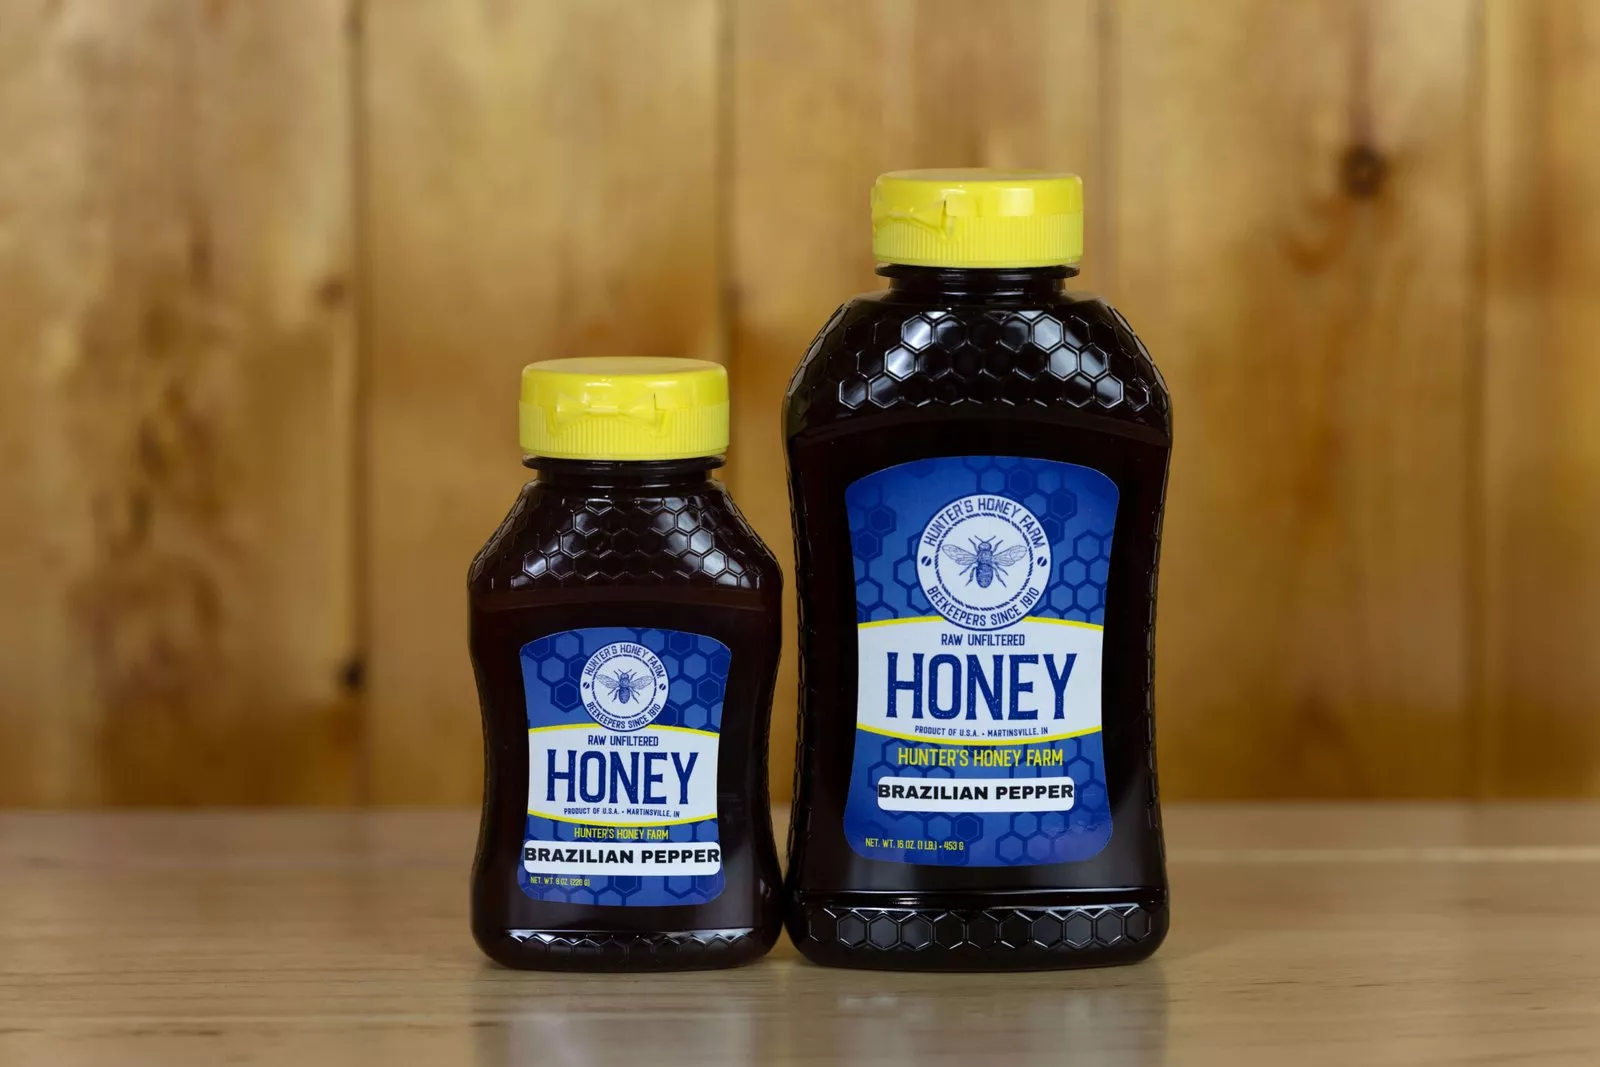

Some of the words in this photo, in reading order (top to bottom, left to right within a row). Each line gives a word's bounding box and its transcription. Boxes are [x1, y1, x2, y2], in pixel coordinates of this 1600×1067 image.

[924, 499, 974, 547] HUNTER'S
[977, 498, 1022, 518] HONEY
[1019, 515, 1046, 549] FARM
[927, 585, 987, 627] BEEKEEPERS
[991, 605, 1022, 626] SINCE
[1019, 587, 1040, 609] 1910
[941, 633, 963, 646] RAW
[968, 633, 1026, 646] UNFILTERED
[584, 645, 618, 676] HUNTER'S
[620, 644, 649, 658] HONEY
[647, 657, 665, 678] FARM
[885, 651, 1078, 721] HONEY
[586, 701, 626, 729] BEEKEEPERS
[628, 715, 649, 729] SINCE
[914, 725, 946, 736] PRODUCT
[948, 728, 957, 736] OF
[1041, 726, 1049, 735] IN
[587, 734, 606, 746] RAW
[610, 735, 659, 747] UNFILTERED
[898, 748, 969, 767] HUNTER'S
[973, 749, 1022, 767] HONEY
[1026, 748, 1063, 767] FARM
[546, 749, 699, 805] HONEY
[878, 784, 989, 800] BRAZILIAN
[995, 784, 1074, 800] PEPPER
[563, 807, 590, 815] PRODUCT
[592, 807, 600, 815] OF
[673, 810, 680, 818] IN
[574, 827, 614, 839] HUNTER'S
[616, 828, 646, 840] HONEY
[646, 829, 669, 840] FARM
[897, 839, 904, 849] 16
[943, 841, 957, 851] 453
[958, 841, 964, 851] G
[524, 847, 634, 864] BRAZILIAN
[641, 848, 720, 864] PEPPER
